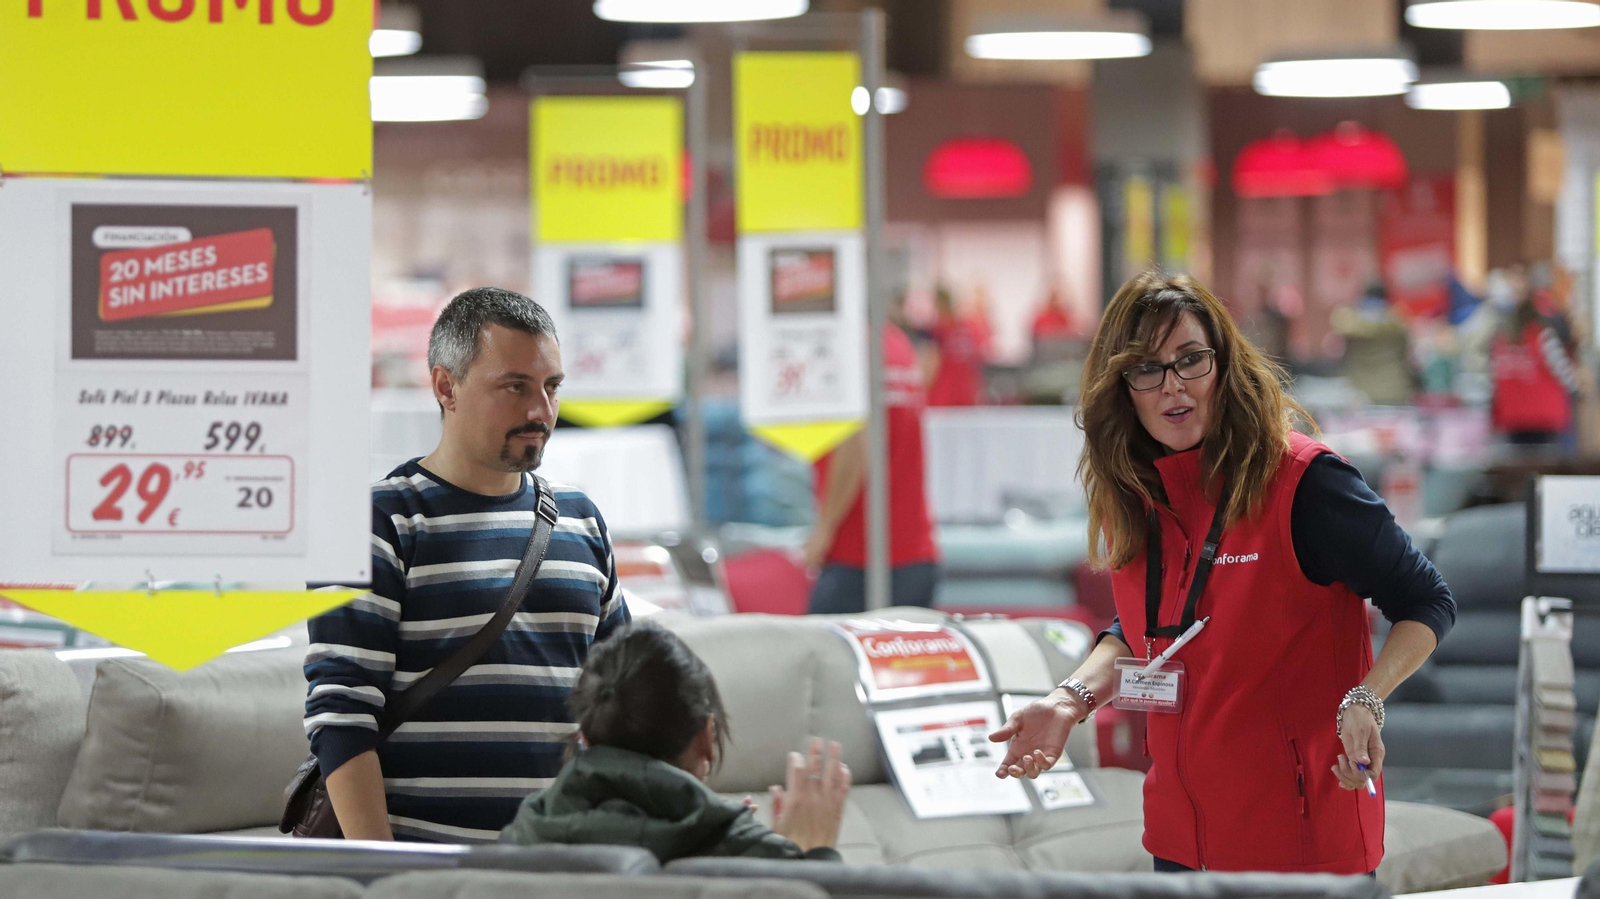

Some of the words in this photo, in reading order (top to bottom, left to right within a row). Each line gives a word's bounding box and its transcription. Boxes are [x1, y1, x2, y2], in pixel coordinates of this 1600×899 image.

[749, 122, 849, 165] PROMO
[547, 154, 666, 191] PROMO
[109, 258, 140, 283] 20
[144, 245, 217, 277] MESES
[108, 282, 145, 308] SIN
[150, 262, 269, 301] INTERESES
[142, 391, 152, 405] 3
[236, 486, 273, 508] 20
[1212, 552, 1259, 565] onforama
[863, 635, 966, 658] Conforama
